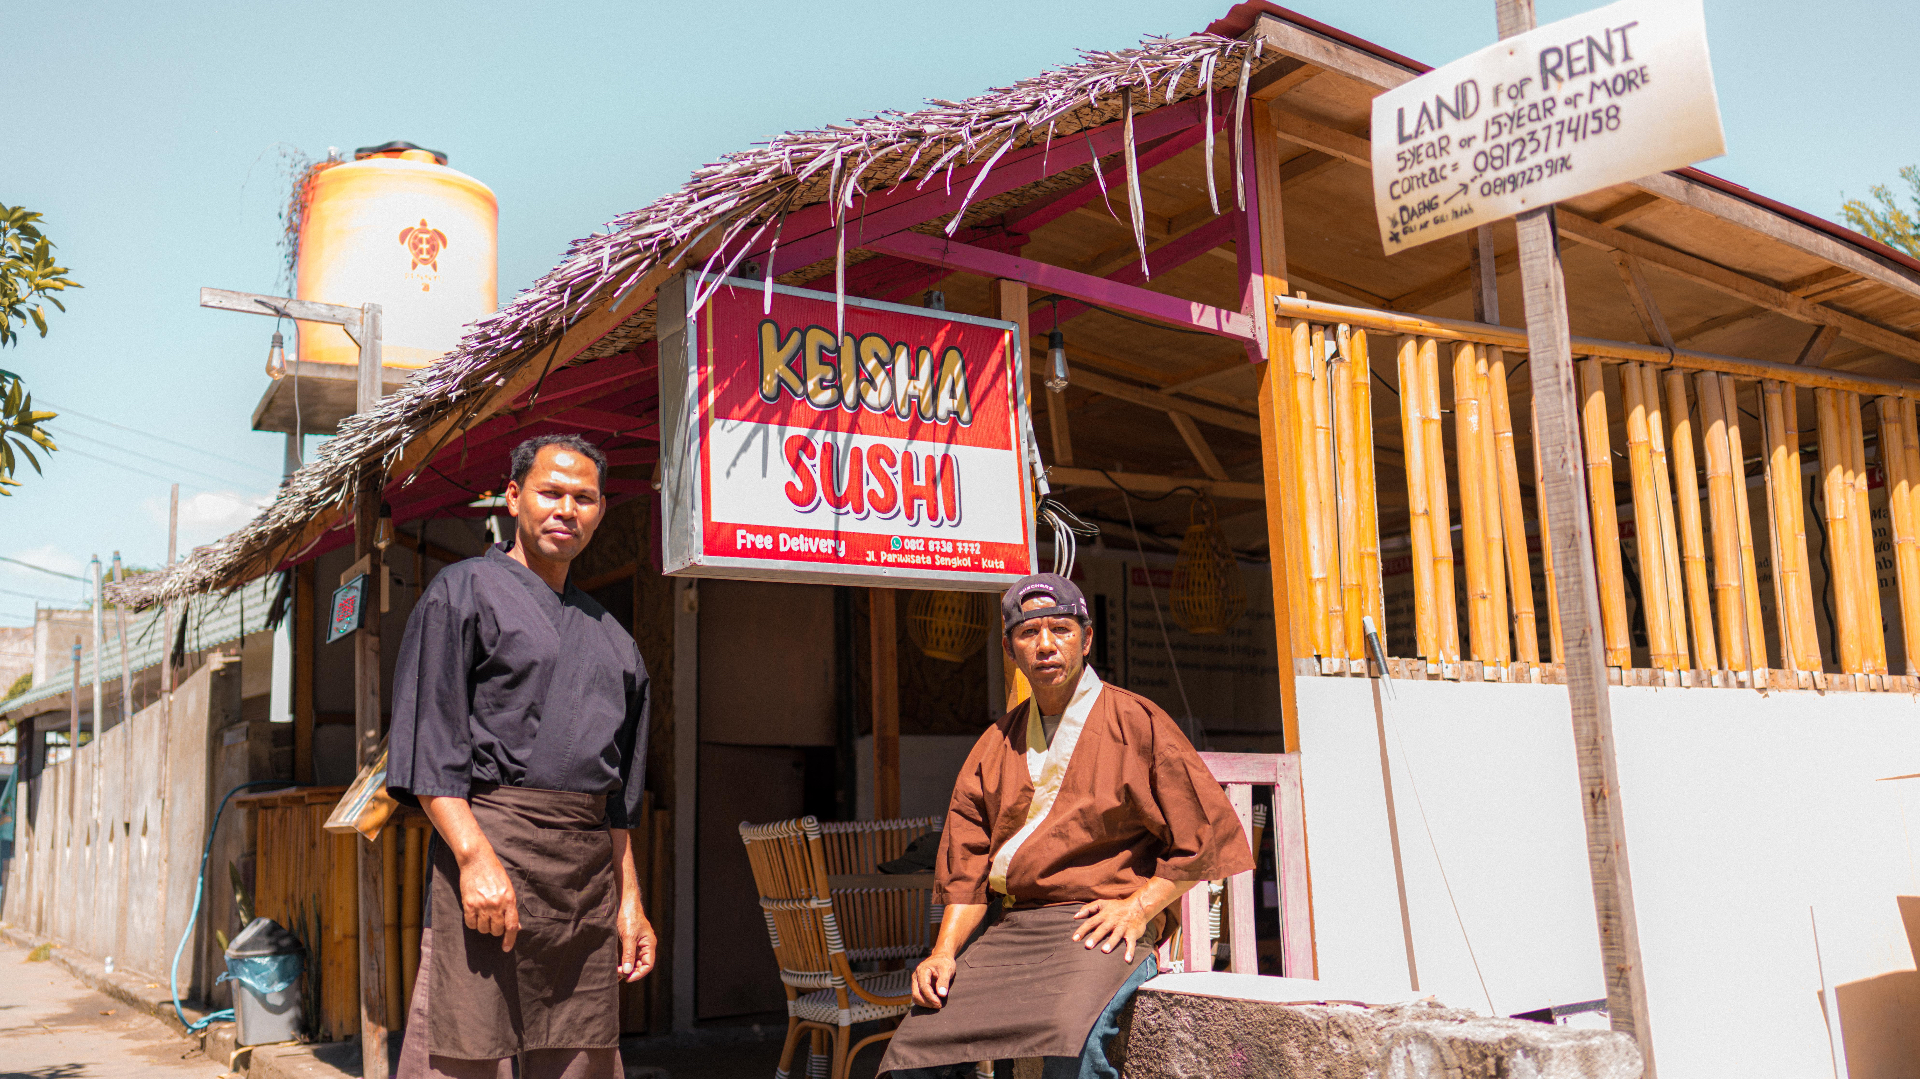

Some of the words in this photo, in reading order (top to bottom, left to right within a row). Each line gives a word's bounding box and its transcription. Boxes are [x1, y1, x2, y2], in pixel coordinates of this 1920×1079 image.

[1397, 79, 1480, 145] LAND
[1539, 20, 1639, 91] RENT
[1589, 65, 1651, 104] MORE
[1473, 104, 1621, 173] 08123774158
[1398, 194, 1440, 226] DAENG
[758, 318, 973, 427] KEISHA
[784, 433, 963, 528] SUSHI
[736, 529, 774, 550] Free
[778, 532, 846, 558] Delivery
[880, 551, 932, 566] Pariwisata
[934, 554, 972, 569] Sengkol
[981, 558, 1005, 570] Kuta
[904, 538, 925, 551] 0812
[928, 540, 953, 553] 8738
[956, 542, 981, 555] 7772
